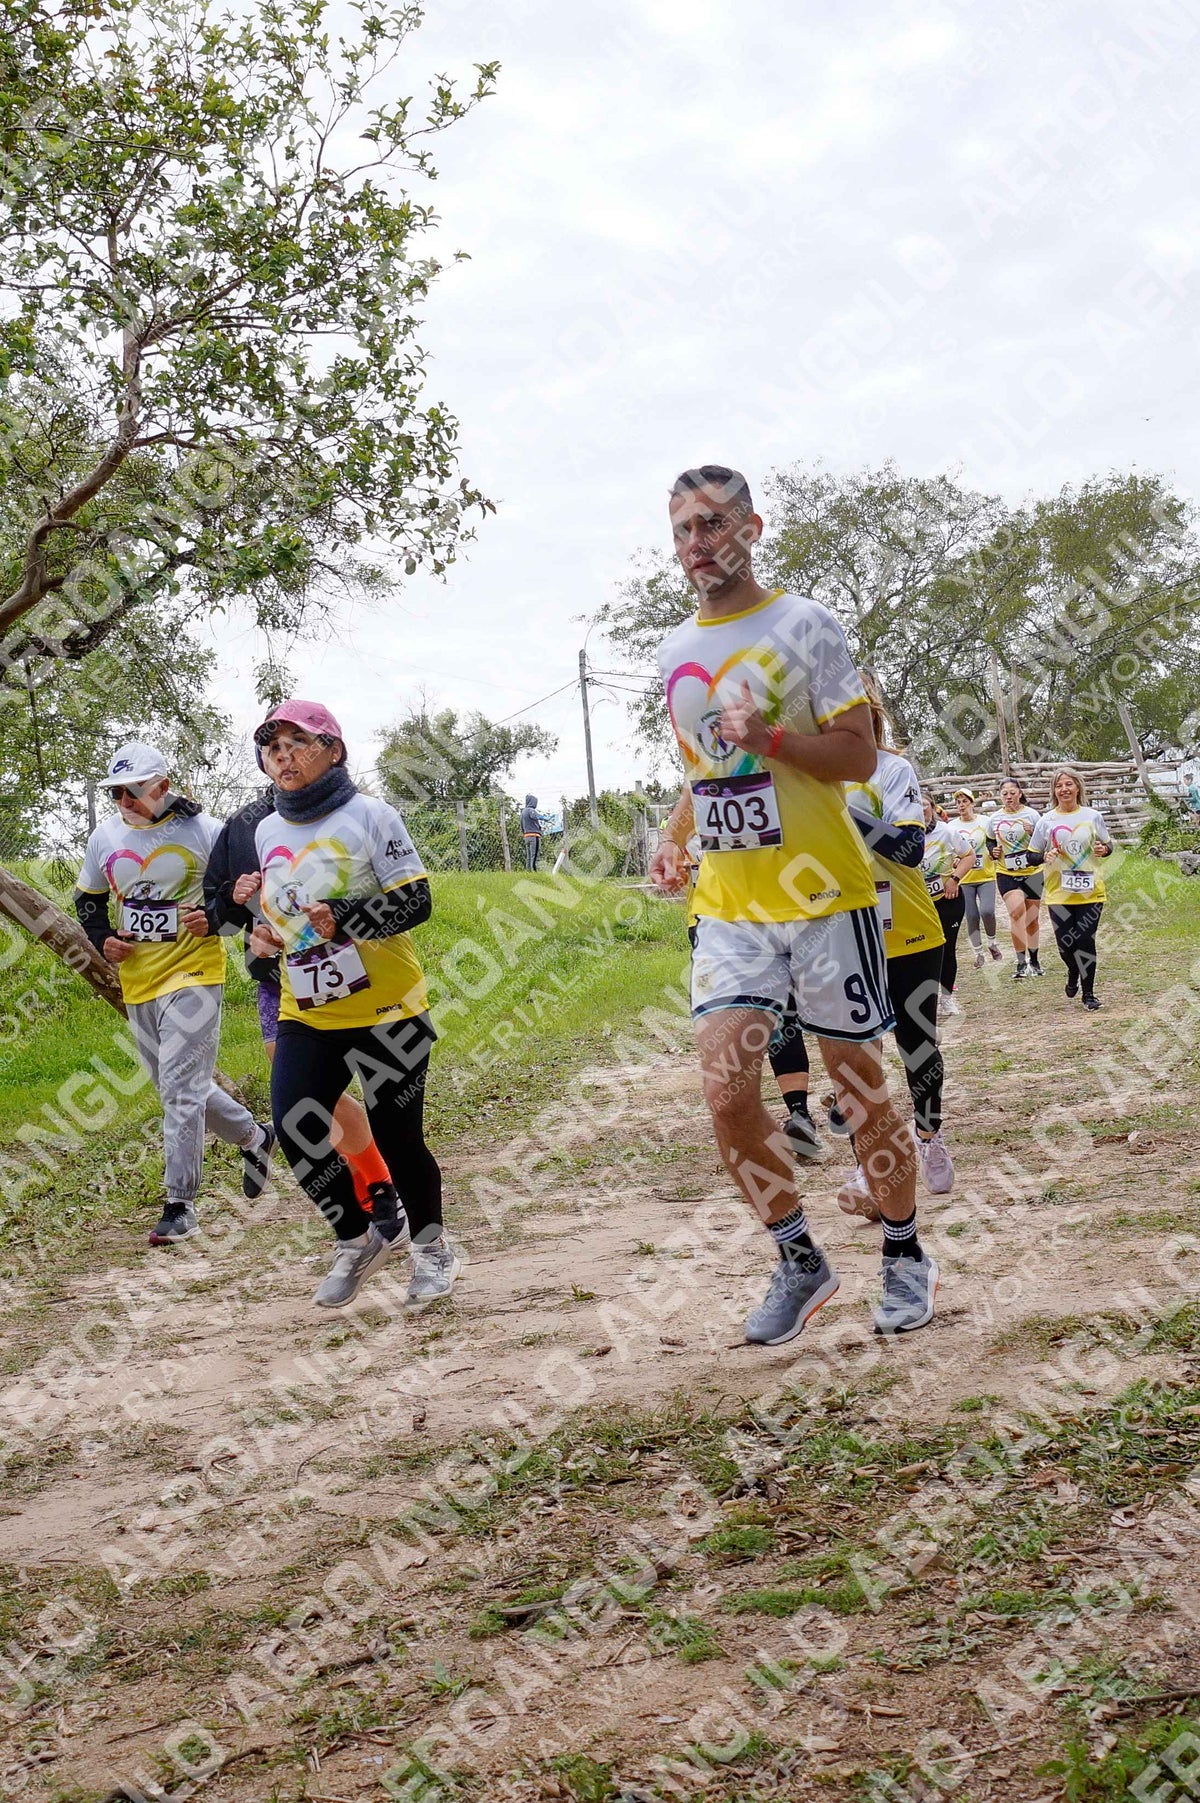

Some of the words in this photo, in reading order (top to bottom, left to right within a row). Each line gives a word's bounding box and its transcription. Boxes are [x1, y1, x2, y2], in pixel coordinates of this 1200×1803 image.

[707, 797, 769, 834] 403
[1014, 857, 1022, 867] 6
[1066, 877, 1090, 889] 455
[809, 889, 841, 903] panda
[130, 912, 170, 933] 262
[303, 961, 344, 994] 73
[844, 973, 871, 1024] 9
[376, 1003, 402, 1016] panda
